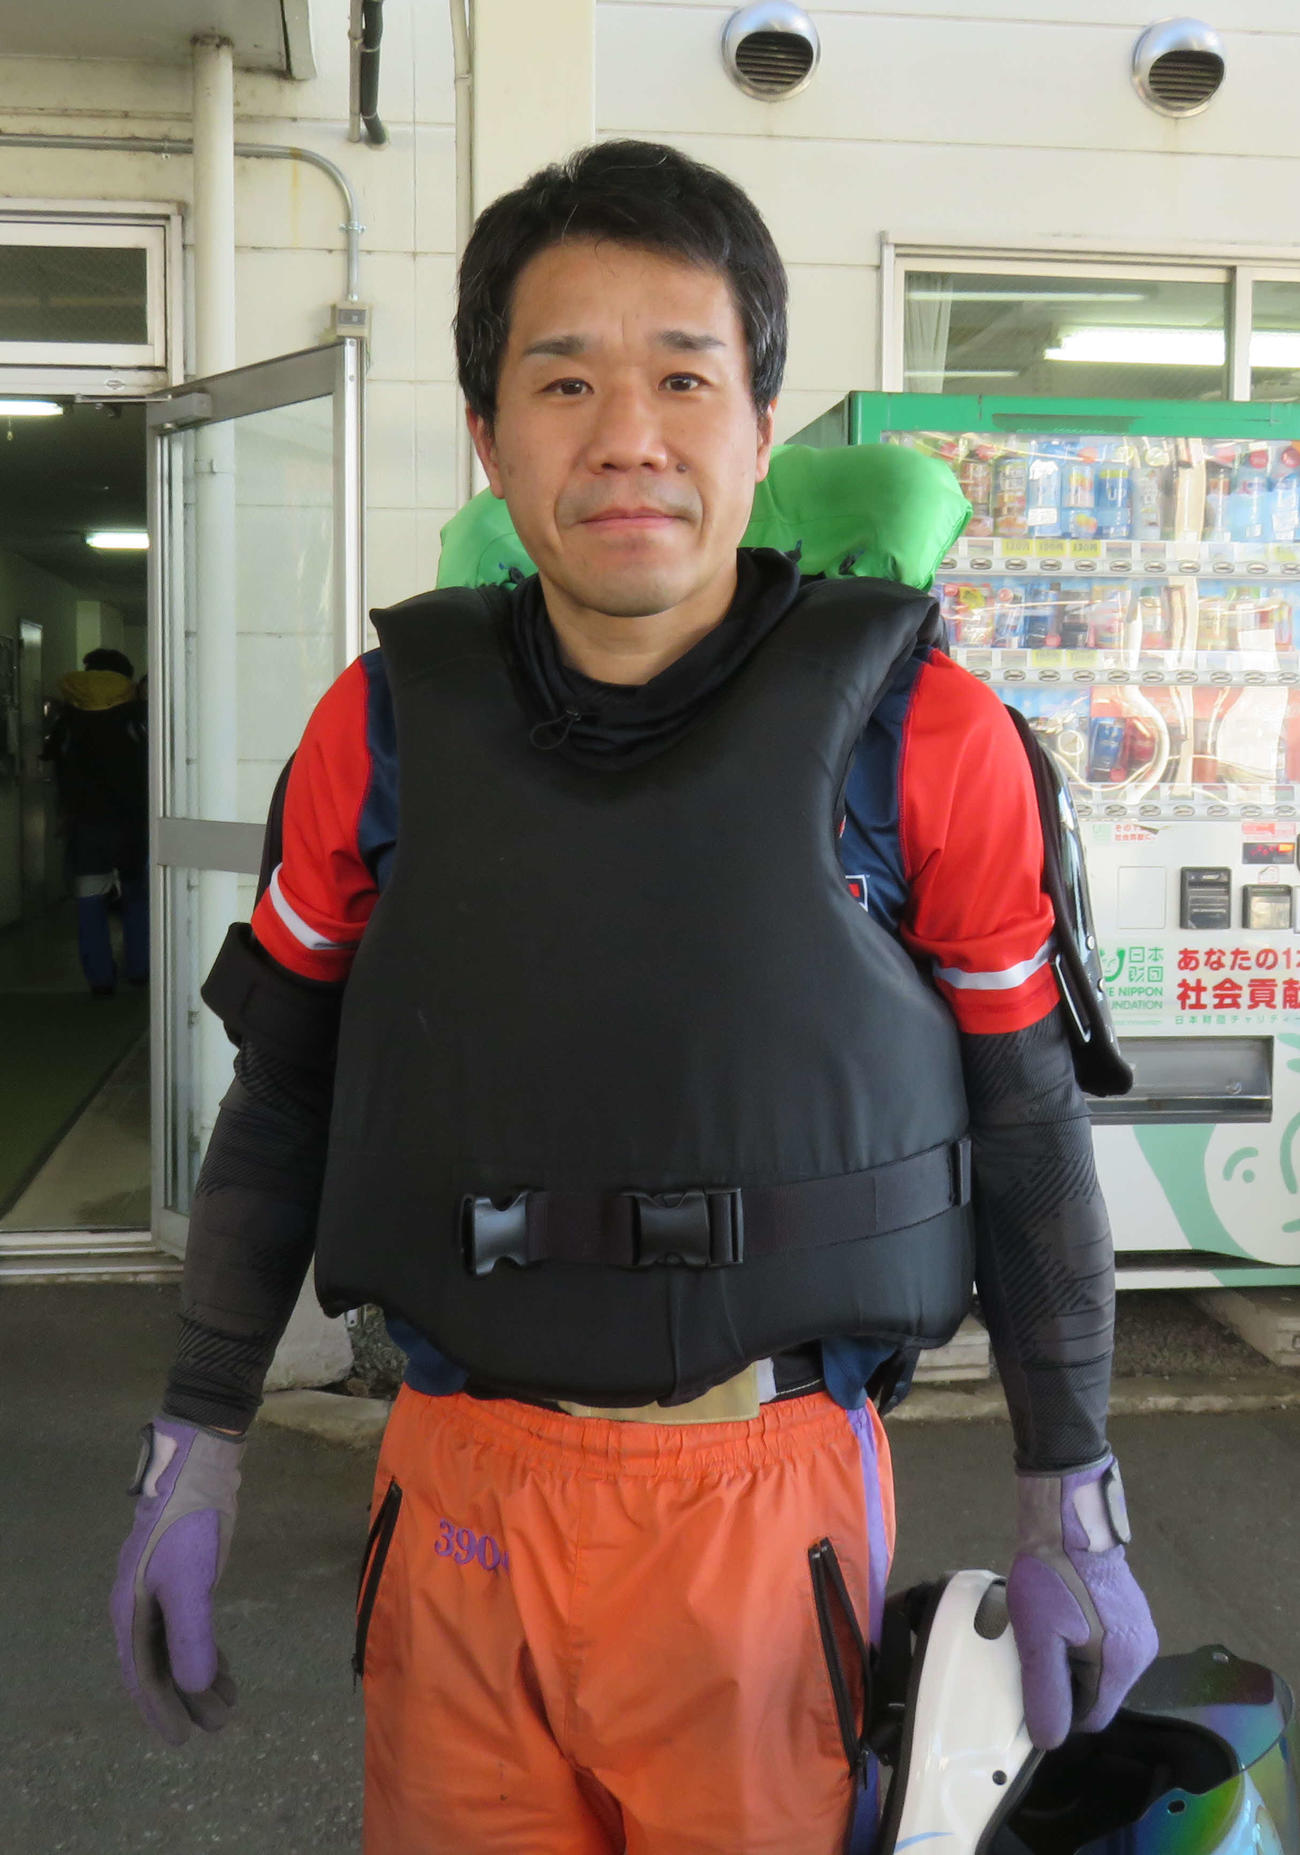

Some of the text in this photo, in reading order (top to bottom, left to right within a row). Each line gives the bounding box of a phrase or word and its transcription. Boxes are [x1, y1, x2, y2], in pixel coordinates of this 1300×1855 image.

[1129, 947, 1164, 963] 日本
[1177, 947, 1300, 971] あなたの1
[1118, 987, 1164, 997] NIPPON
